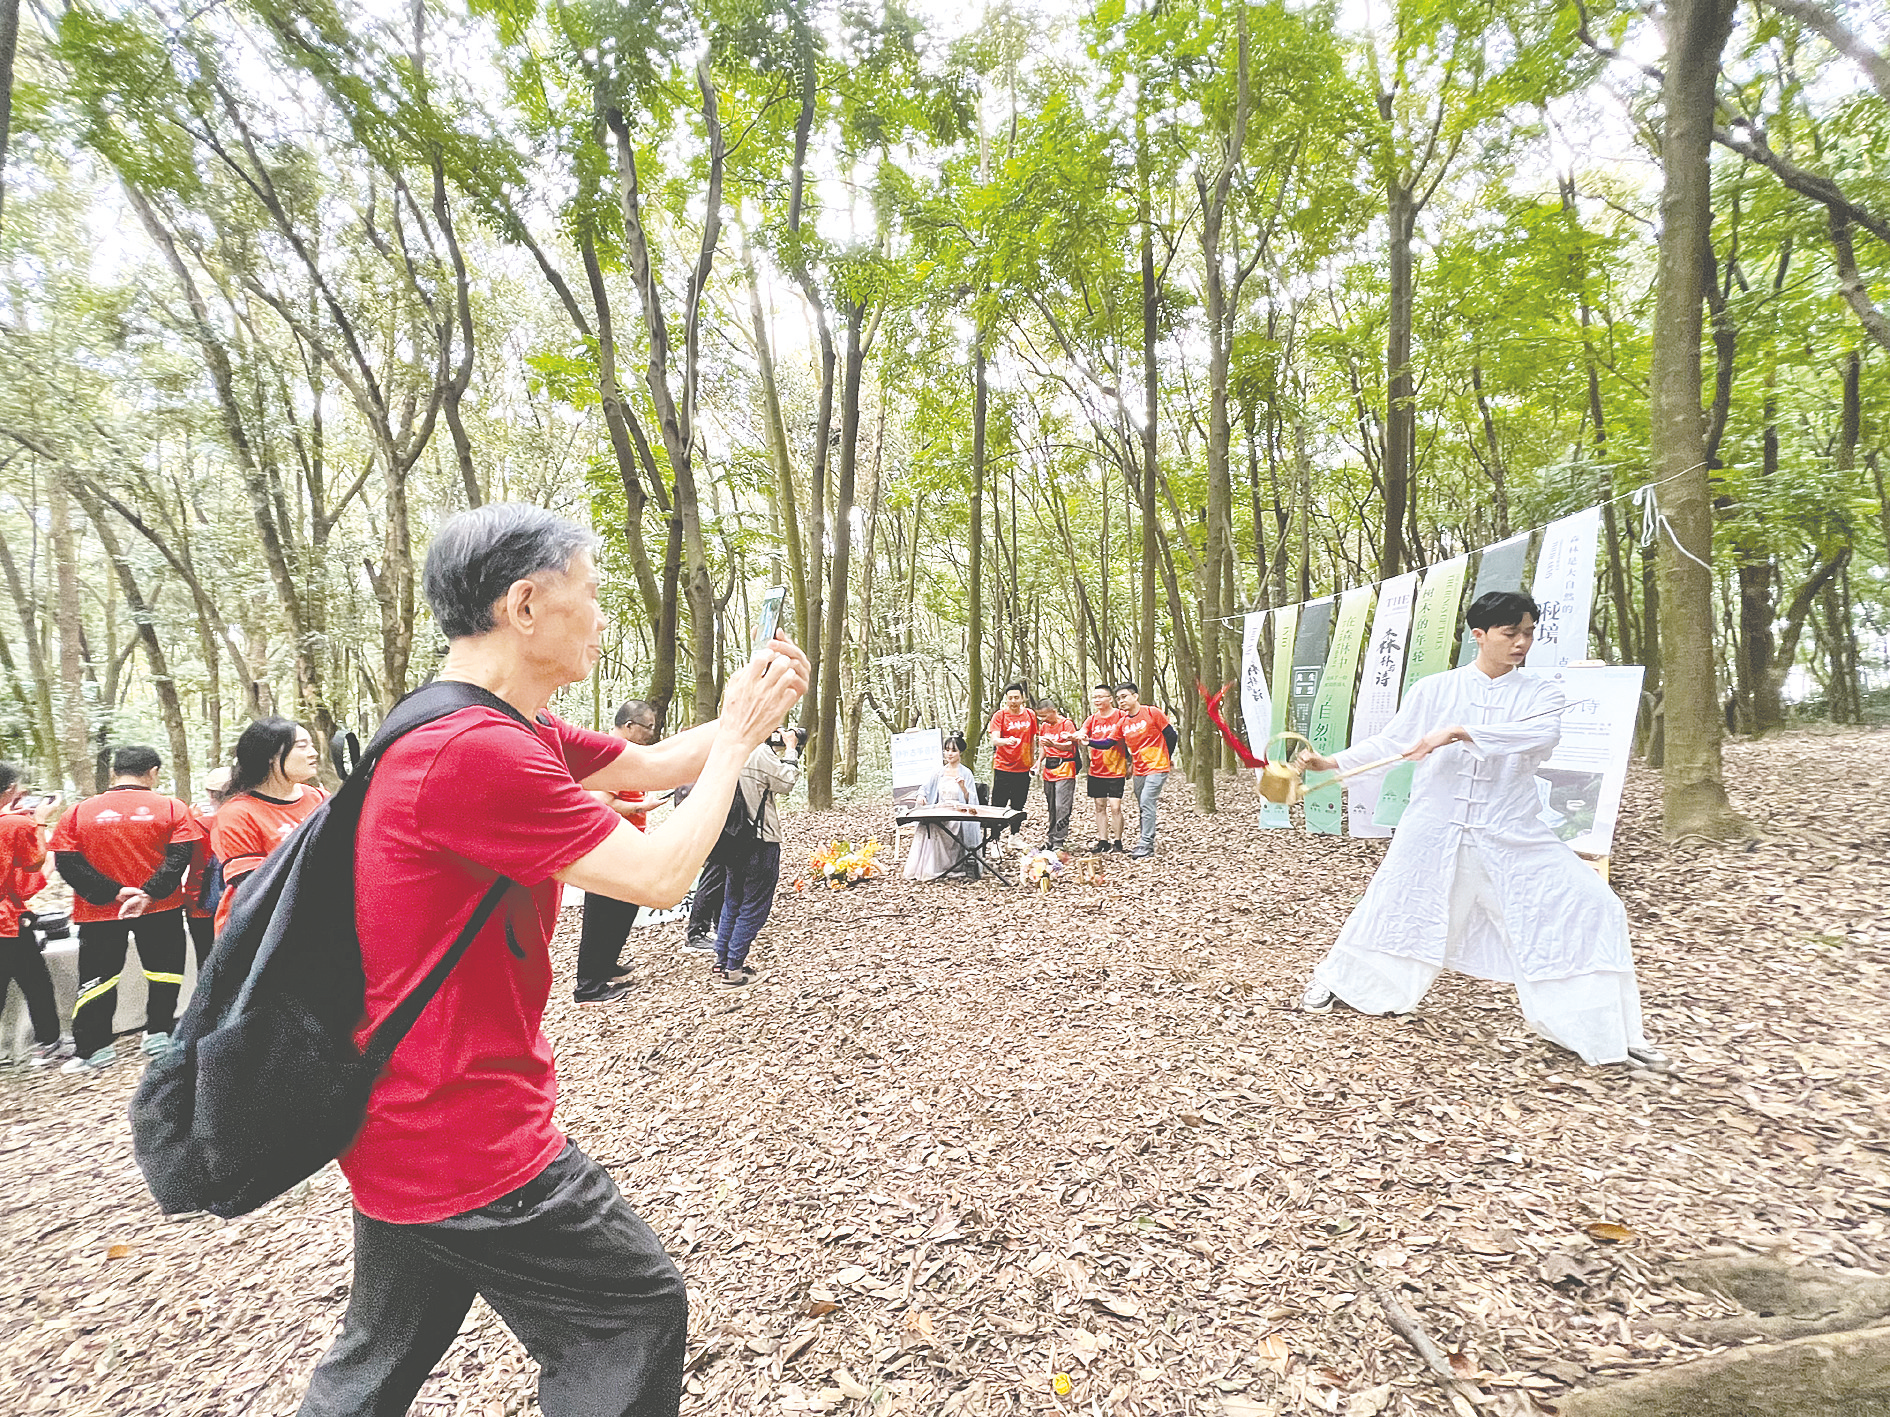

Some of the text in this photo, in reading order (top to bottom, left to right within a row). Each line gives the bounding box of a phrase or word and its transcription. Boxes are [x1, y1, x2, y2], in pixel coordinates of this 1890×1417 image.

[1386, 594, 1410, 608] THE
[1412, 587, 1434, 662] 树木的年轮
[1339, 616, 1356, 669] 在森林中
